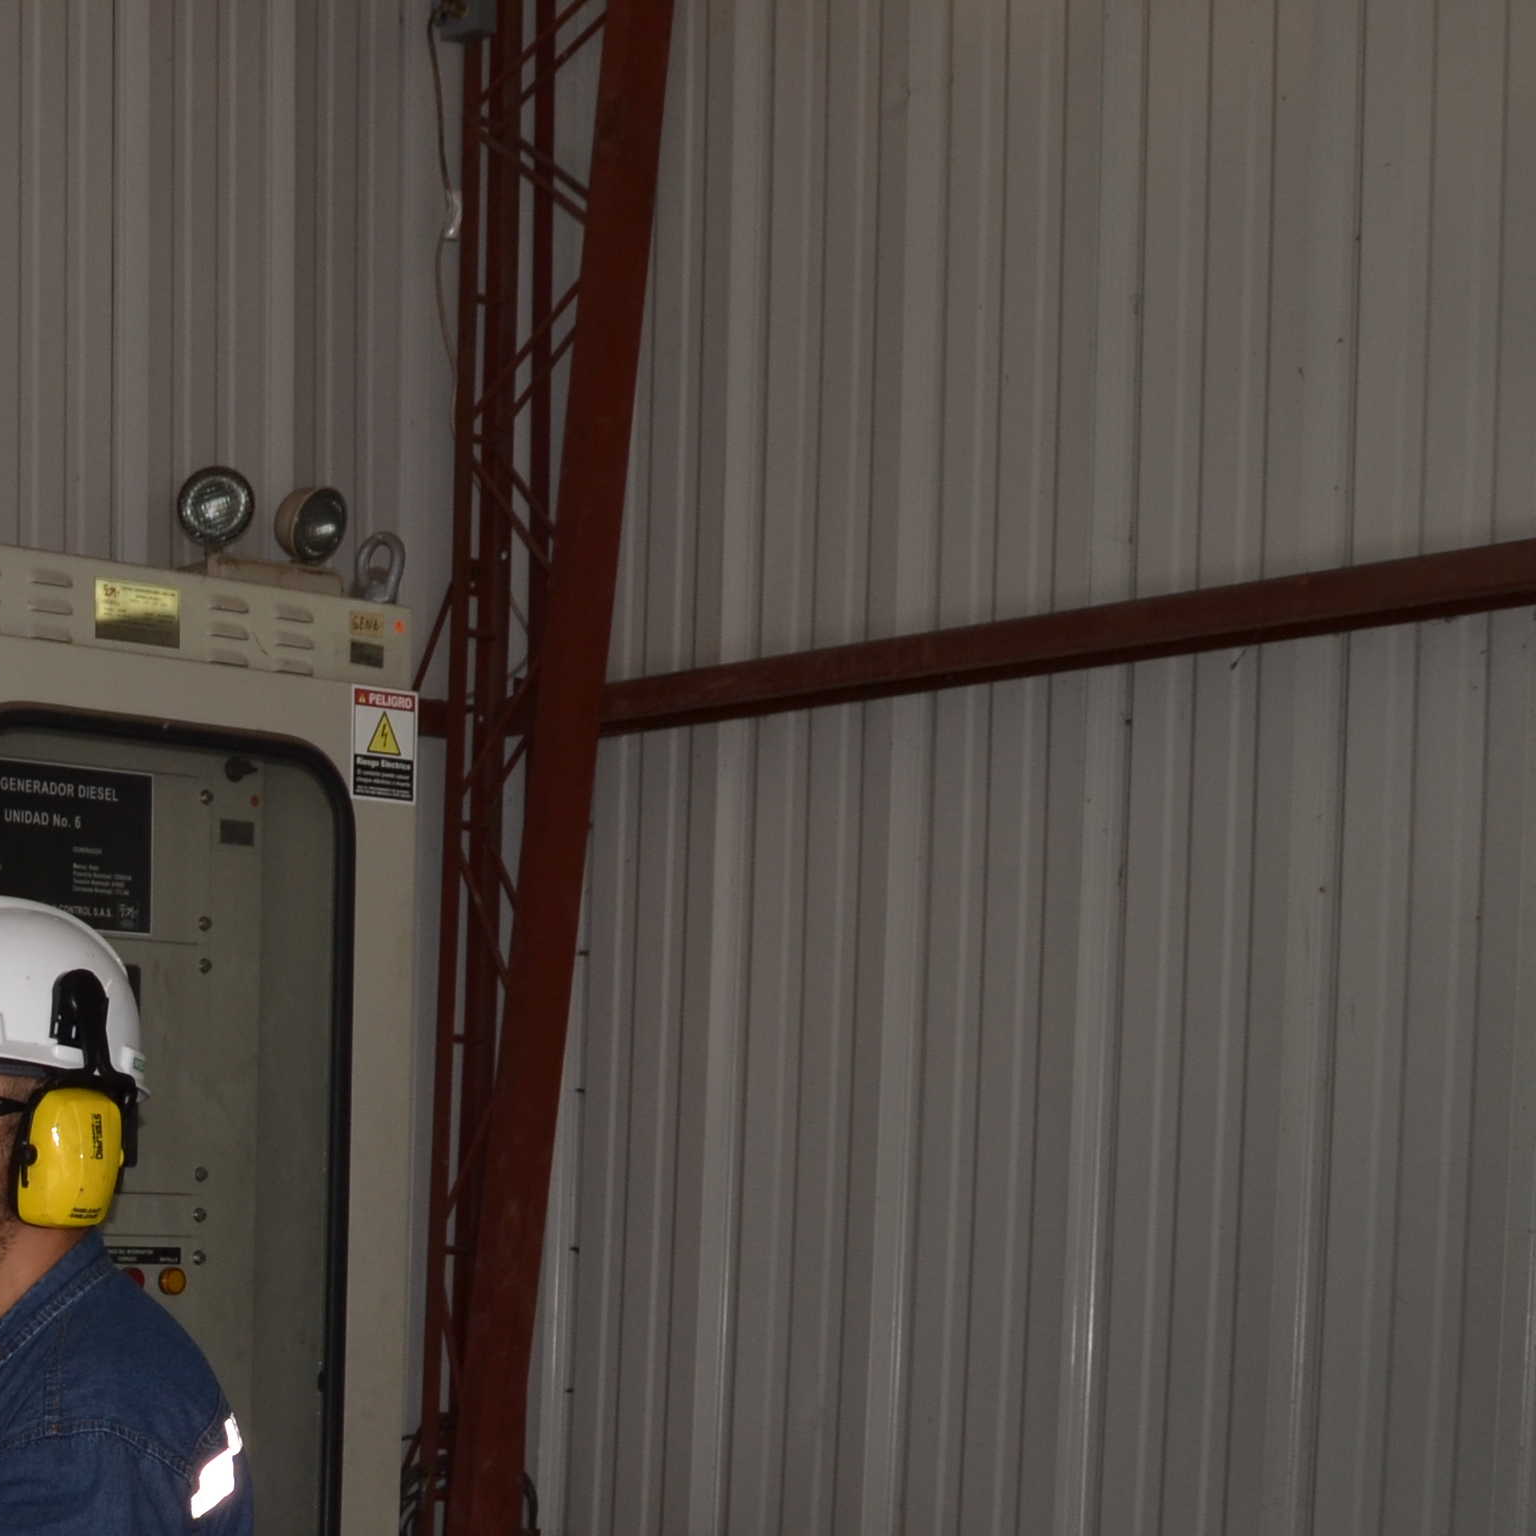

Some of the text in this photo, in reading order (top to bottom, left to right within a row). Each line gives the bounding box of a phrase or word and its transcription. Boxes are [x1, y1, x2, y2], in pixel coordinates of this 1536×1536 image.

[369, 693, 412, 710] PELIGRO
[356, 756, 379, 768] Riesgo
[78, 785, 119, 802] DIESEL
[4, 808, 82, 829] UNIDAD No. 6
